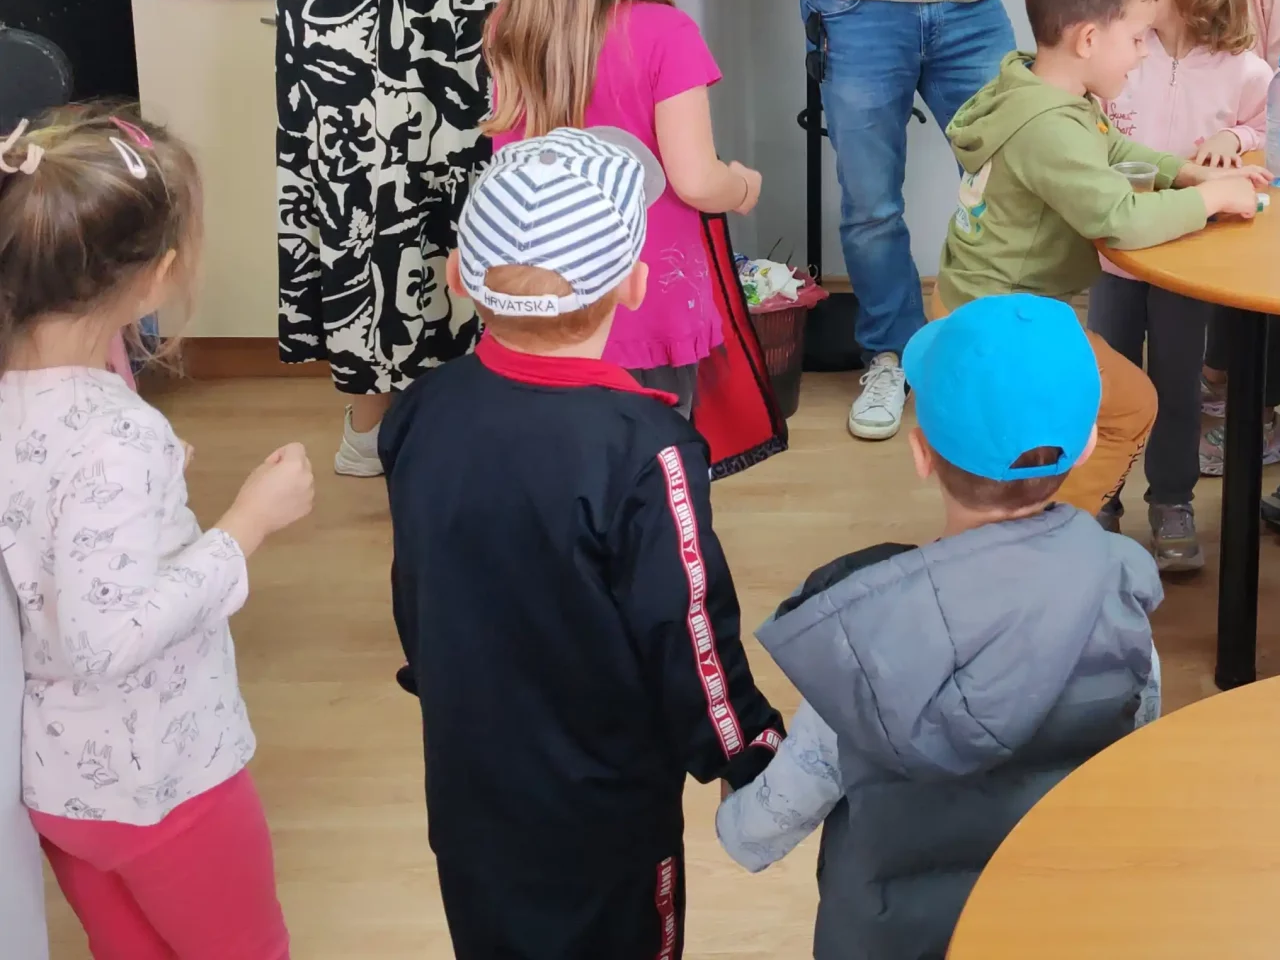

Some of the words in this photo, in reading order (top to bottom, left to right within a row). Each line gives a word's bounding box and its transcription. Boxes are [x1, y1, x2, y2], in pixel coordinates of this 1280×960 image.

[484, 292, 556, 312] HRVATSKA
[672, 488, 685, 503] OF
[676, 504, 695, 543] BRAND
[687, 559, 704, 600] FLIGHT
[691, 614, 712, 654] BRAND
[712, 703, 727, 719] OF
[719, 717, 740, 751] BRAND
